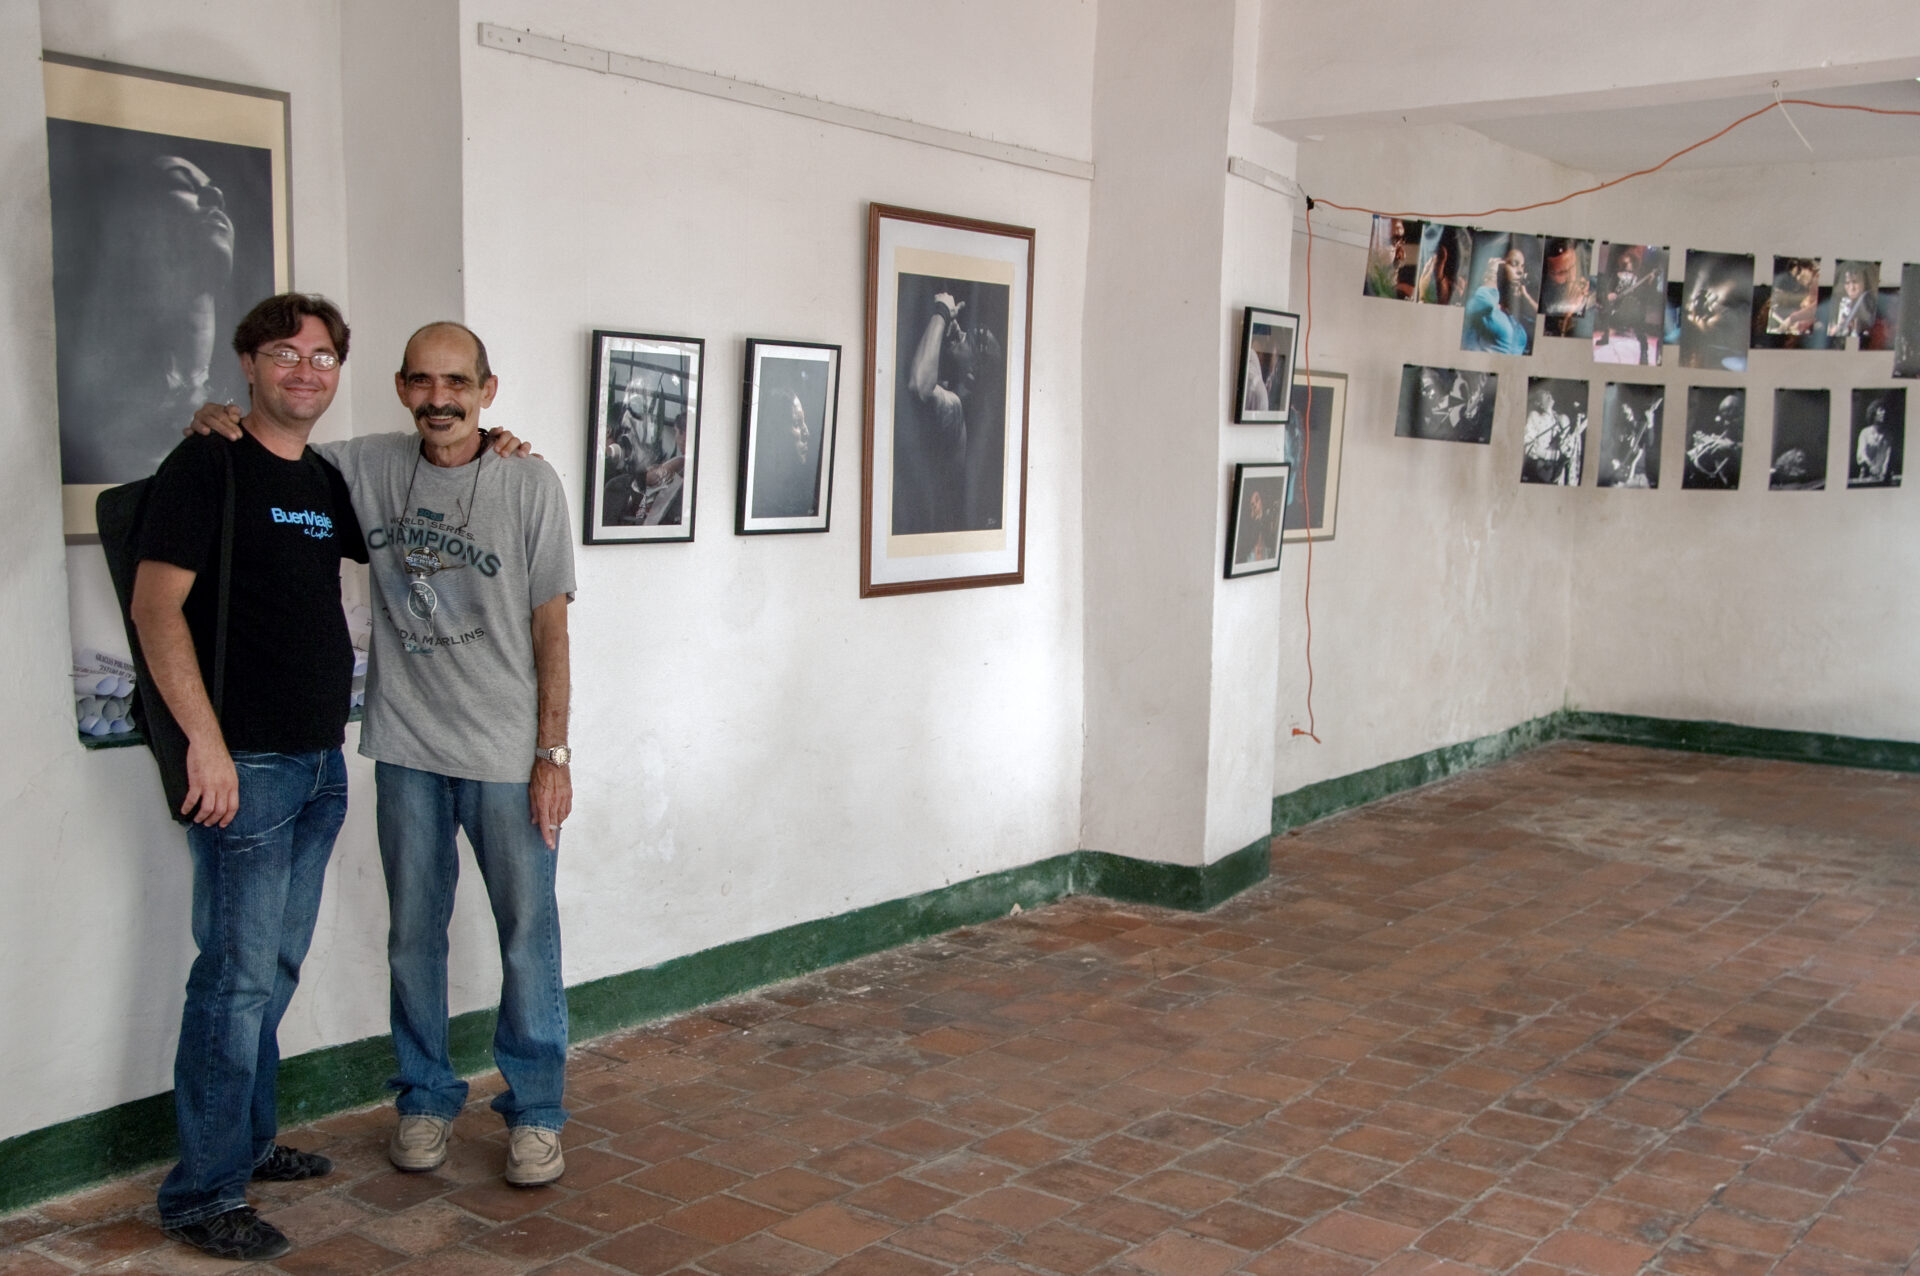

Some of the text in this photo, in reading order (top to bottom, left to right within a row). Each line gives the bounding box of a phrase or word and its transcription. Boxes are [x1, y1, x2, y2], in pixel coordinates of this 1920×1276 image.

[271, 507, 333, 531] BuenViaje
[390, 517, 473, 540] WORLD SERIES
[367, 527, 502, 578] CHAMPIONS
[422, 627, 485, 646] MARLINS
